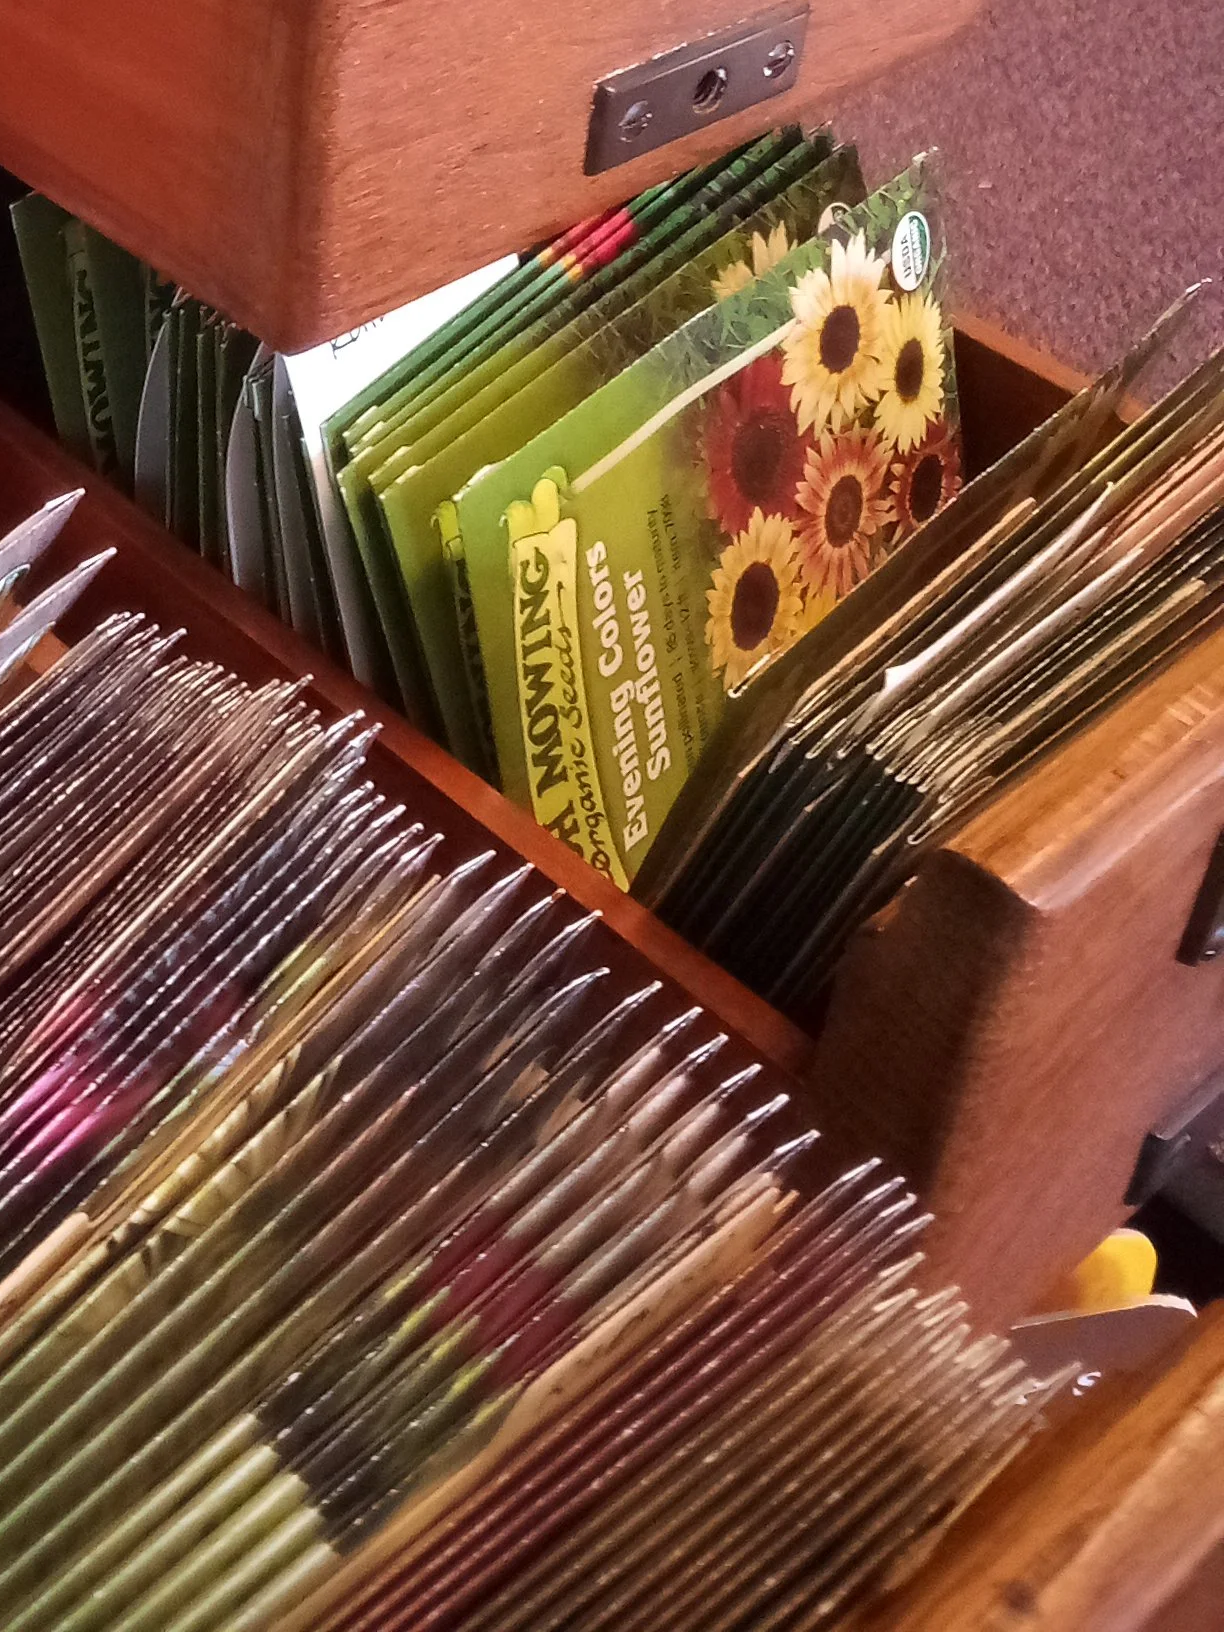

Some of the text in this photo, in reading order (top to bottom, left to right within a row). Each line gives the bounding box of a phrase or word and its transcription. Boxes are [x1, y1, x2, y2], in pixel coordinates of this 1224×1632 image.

[520, 545, 570, 800] MOWING
[556, 580, 584, 730] Seeds
[585, 540, 649, 853] Evening Colors
[623, 568, 671, 782] Sunflower
